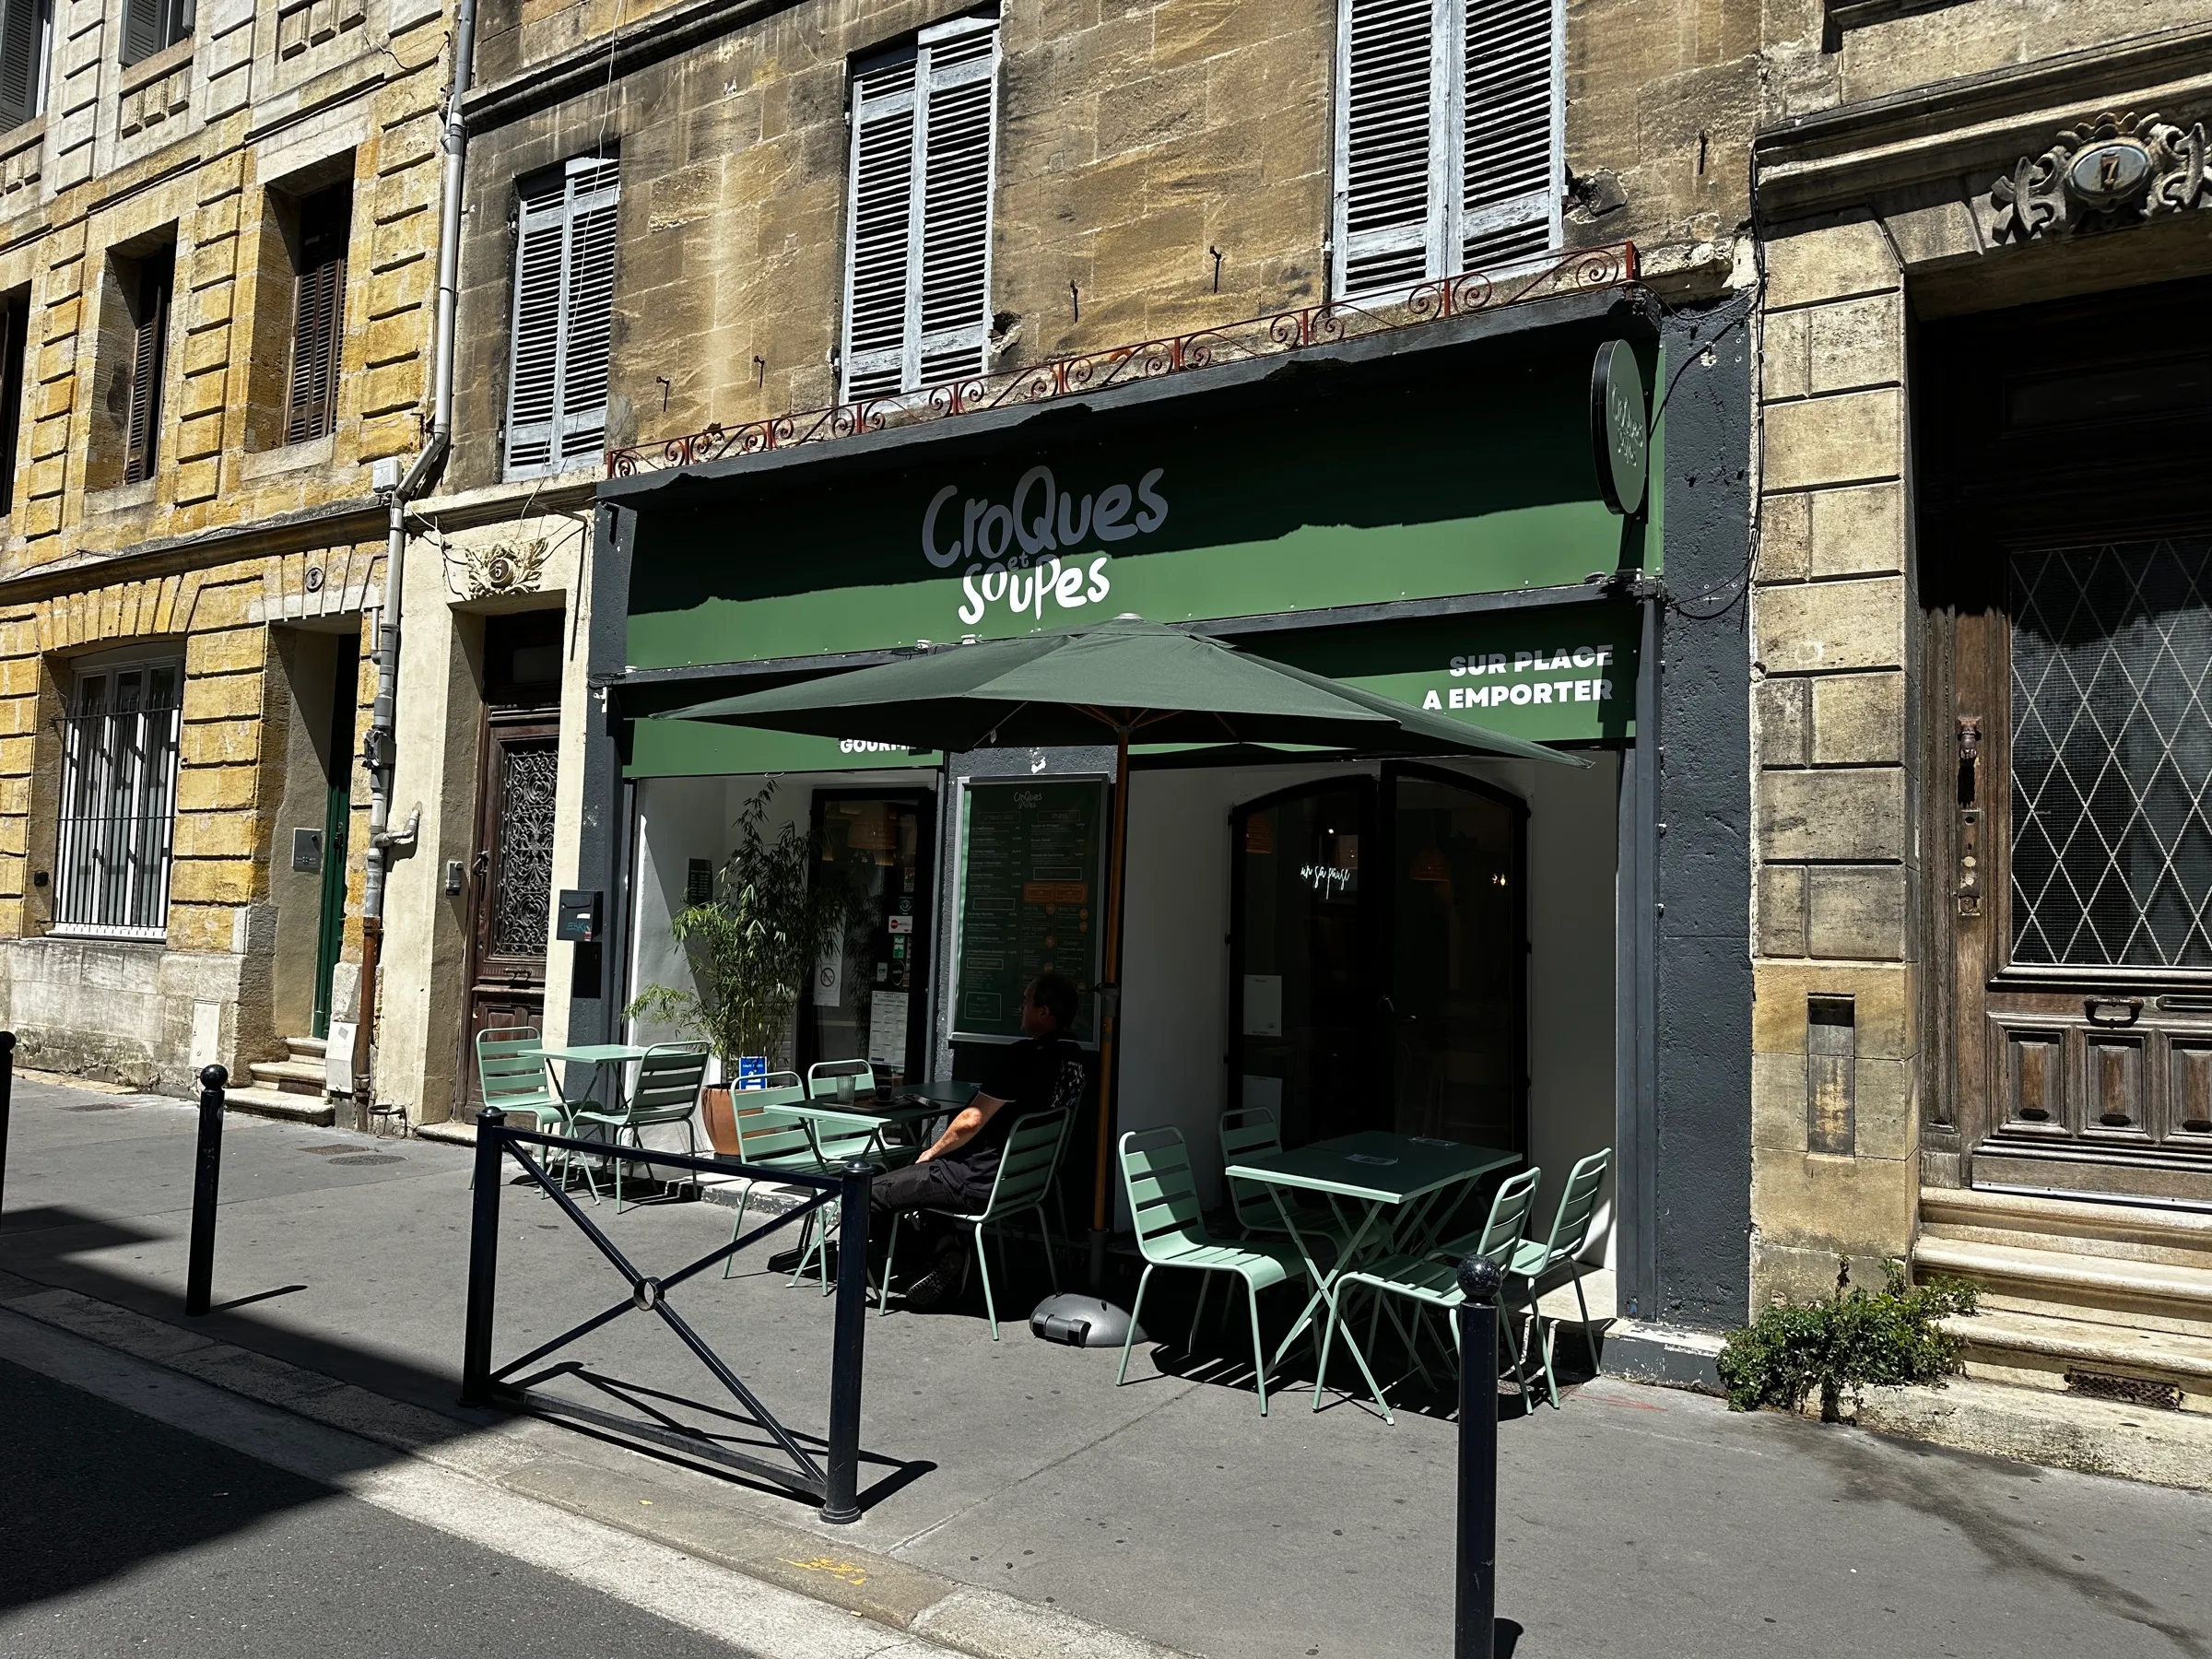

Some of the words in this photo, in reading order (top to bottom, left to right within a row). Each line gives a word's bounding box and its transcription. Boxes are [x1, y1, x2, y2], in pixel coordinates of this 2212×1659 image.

[2100, 154, 2121, 185] 7
[922, 465, 1169, 568] CroQues
[495, 563, 502, 577] 5
[1449, 653, 1507, 677] SUR
[1513, 644, 1614, 672] PLACE
[1422, 689, 1442, 711] A
[1449, 678, 1613, 709] EMPORTER
